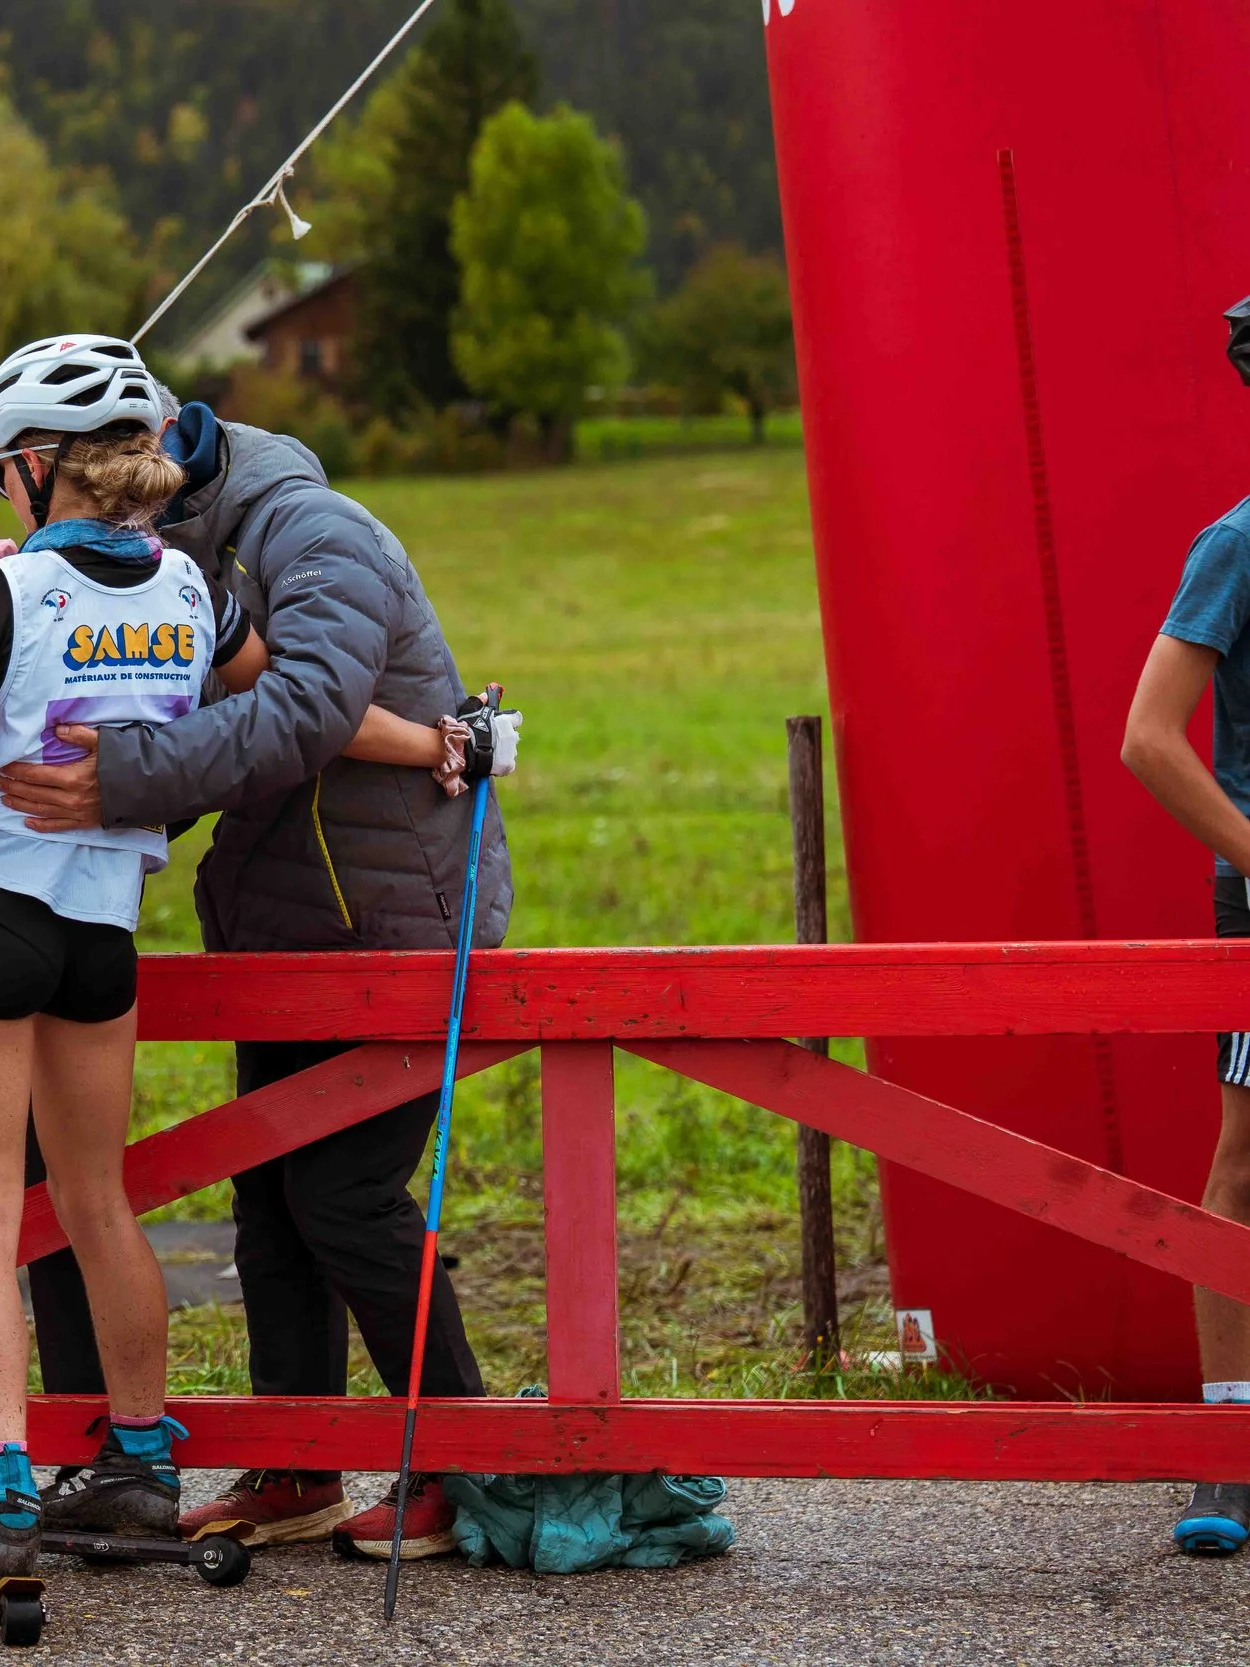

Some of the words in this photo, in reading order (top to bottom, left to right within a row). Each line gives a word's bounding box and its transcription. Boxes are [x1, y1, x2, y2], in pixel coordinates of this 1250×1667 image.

[288, 569, 322, 584] Schöffel
[63, 622, 195, 671] SAMSE
[64, 673, 117, 684] MATÉRIAUX
[120, 672, 133, 680] DE
[134, 672, 191, 681] CONSTRUCTION
